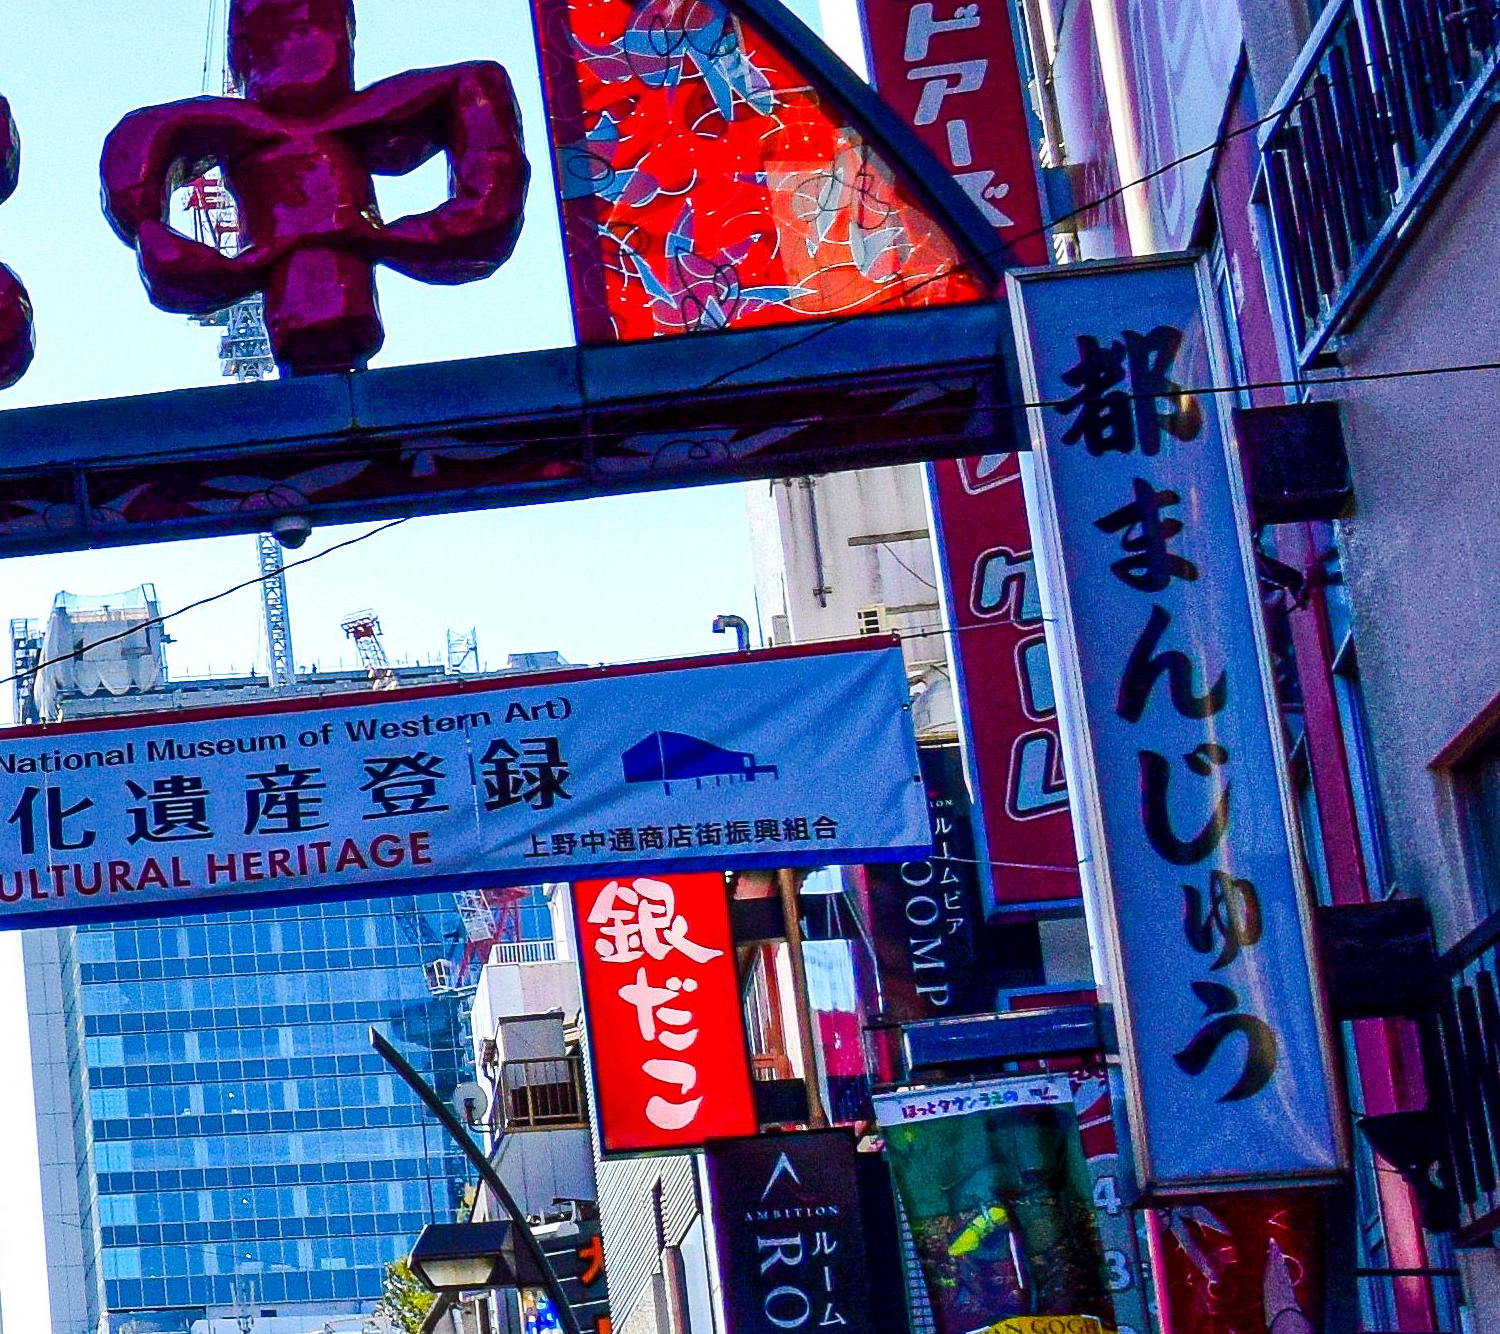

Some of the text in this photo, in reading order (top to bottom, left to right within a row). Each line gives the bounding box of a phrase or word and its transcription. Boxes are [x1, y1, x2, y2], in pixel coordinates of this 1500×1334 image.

[146, 730, 288, 765] Museum
[298, 722, 334, 749] of
[344, 707, 491, 745] Western
[503, 694, 574, 727] Art)
[1053, 323, 1280, 1103] 都まんじゅう
[205, 830, 433, 887] HERITAGE
[524, 814, 840, 858] 上野中通商店街振興組合
[585, 877, 725, 1132] 銀だこ
[743, 1205, 840, 1223] AMBITION
